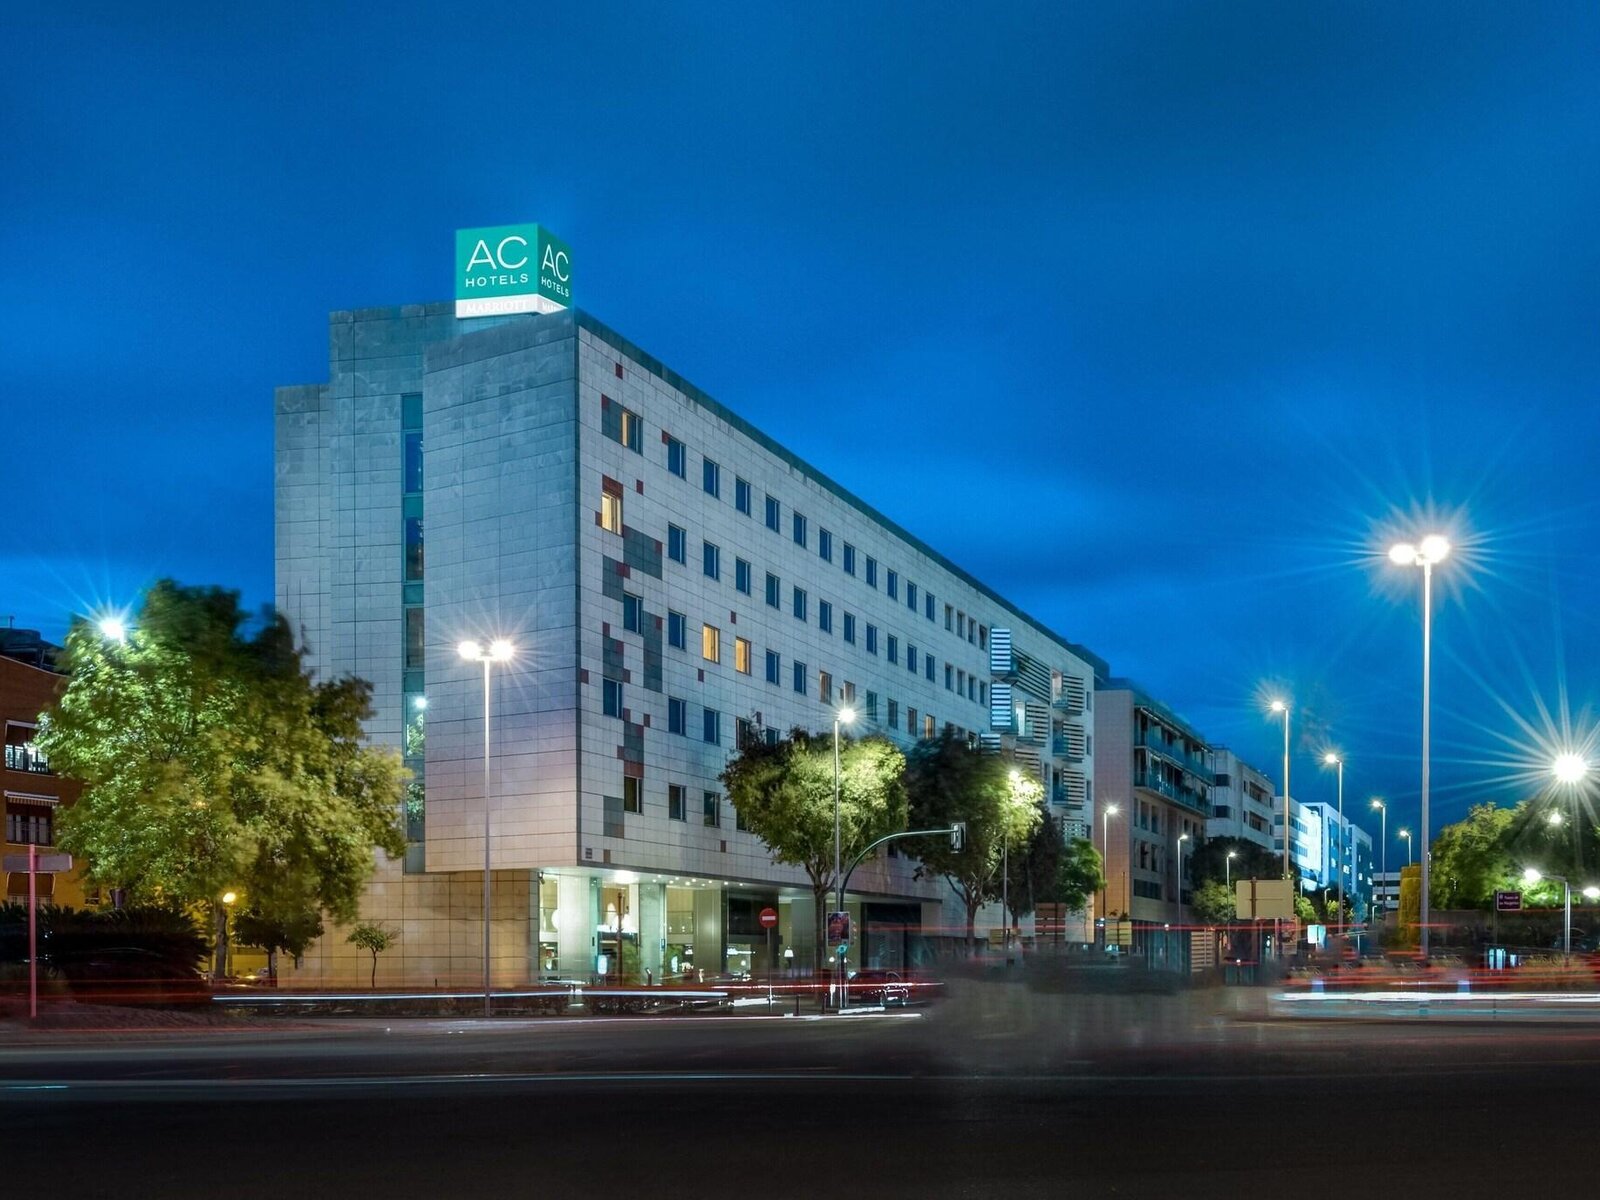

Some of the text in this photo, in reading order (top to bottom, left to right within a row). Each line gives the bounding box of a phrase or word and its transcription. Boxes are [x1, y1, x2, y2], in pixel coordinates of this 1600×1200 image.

[466, 236, 528, 272] AC
[541, 243, 569, 282] AC
[465, 273, 529, 288] HOTELS
[541, 276, 570, 297] HOTELS
[465, 299, 528, 314] MARRIOTT
